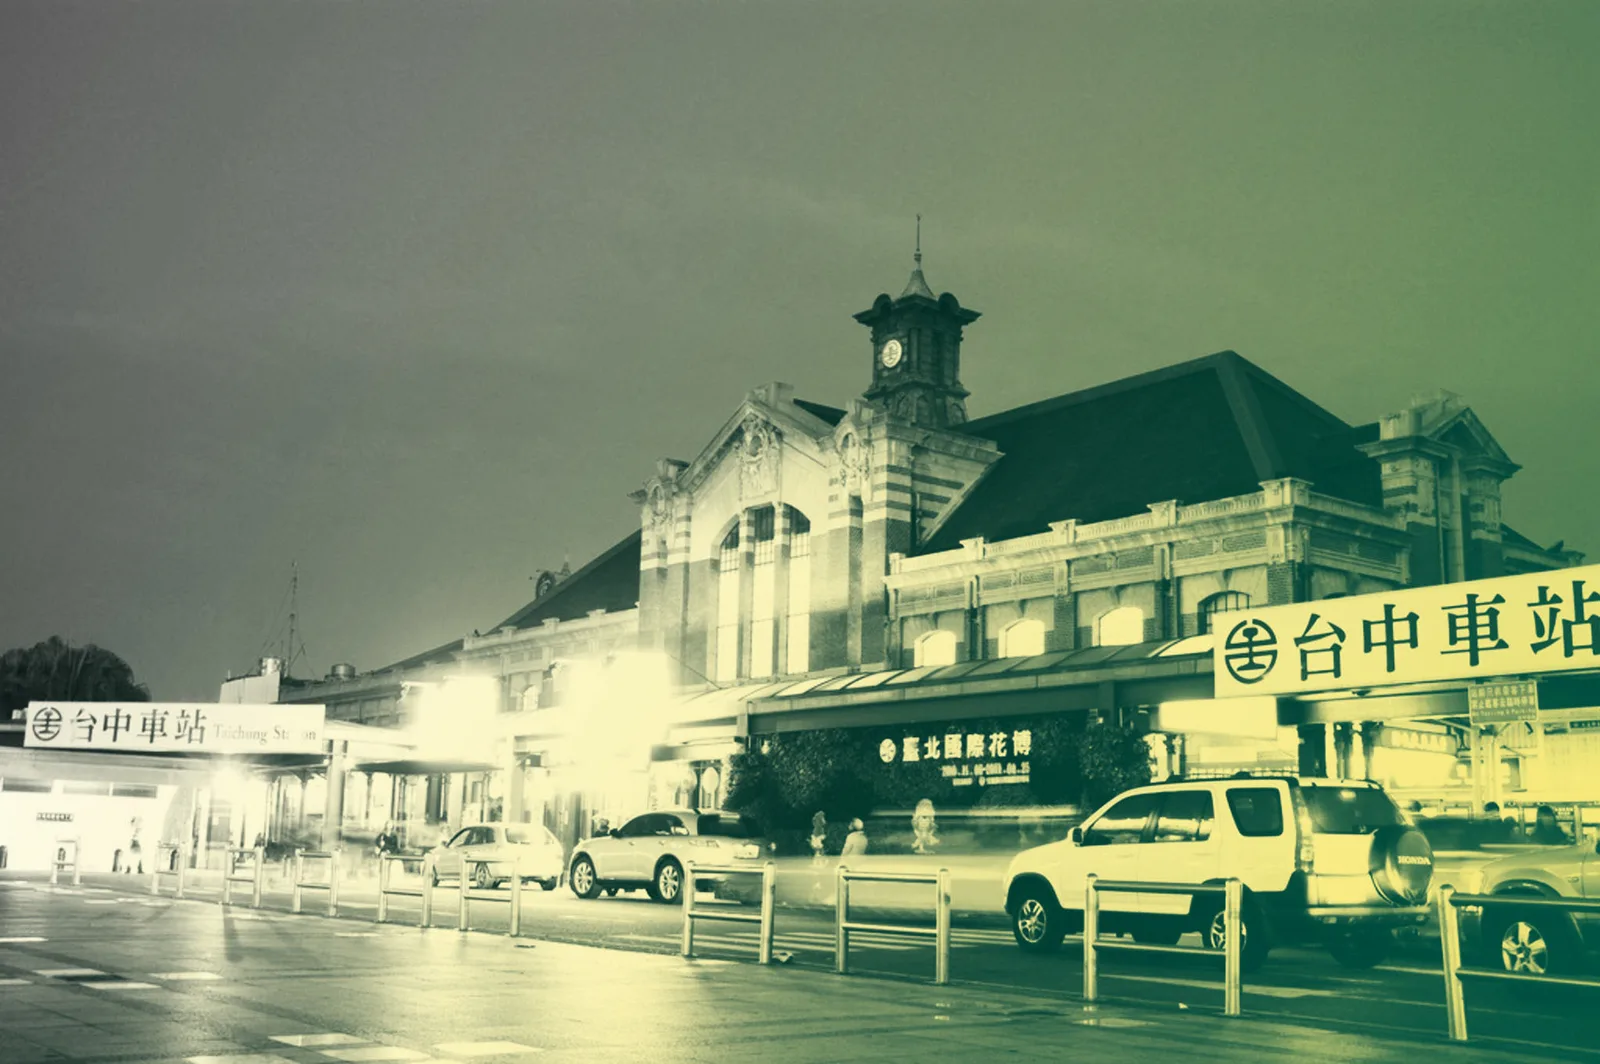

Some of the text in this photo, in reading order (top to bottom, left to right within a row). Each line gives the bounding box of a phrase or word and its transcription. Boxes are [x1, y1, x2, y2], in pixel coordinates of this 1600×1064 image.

[1293, 579, 1600, 682] 台中車站
[71, 707, 207, 744] 台中車站
[1397, 855, 1431, 865] HONDA
